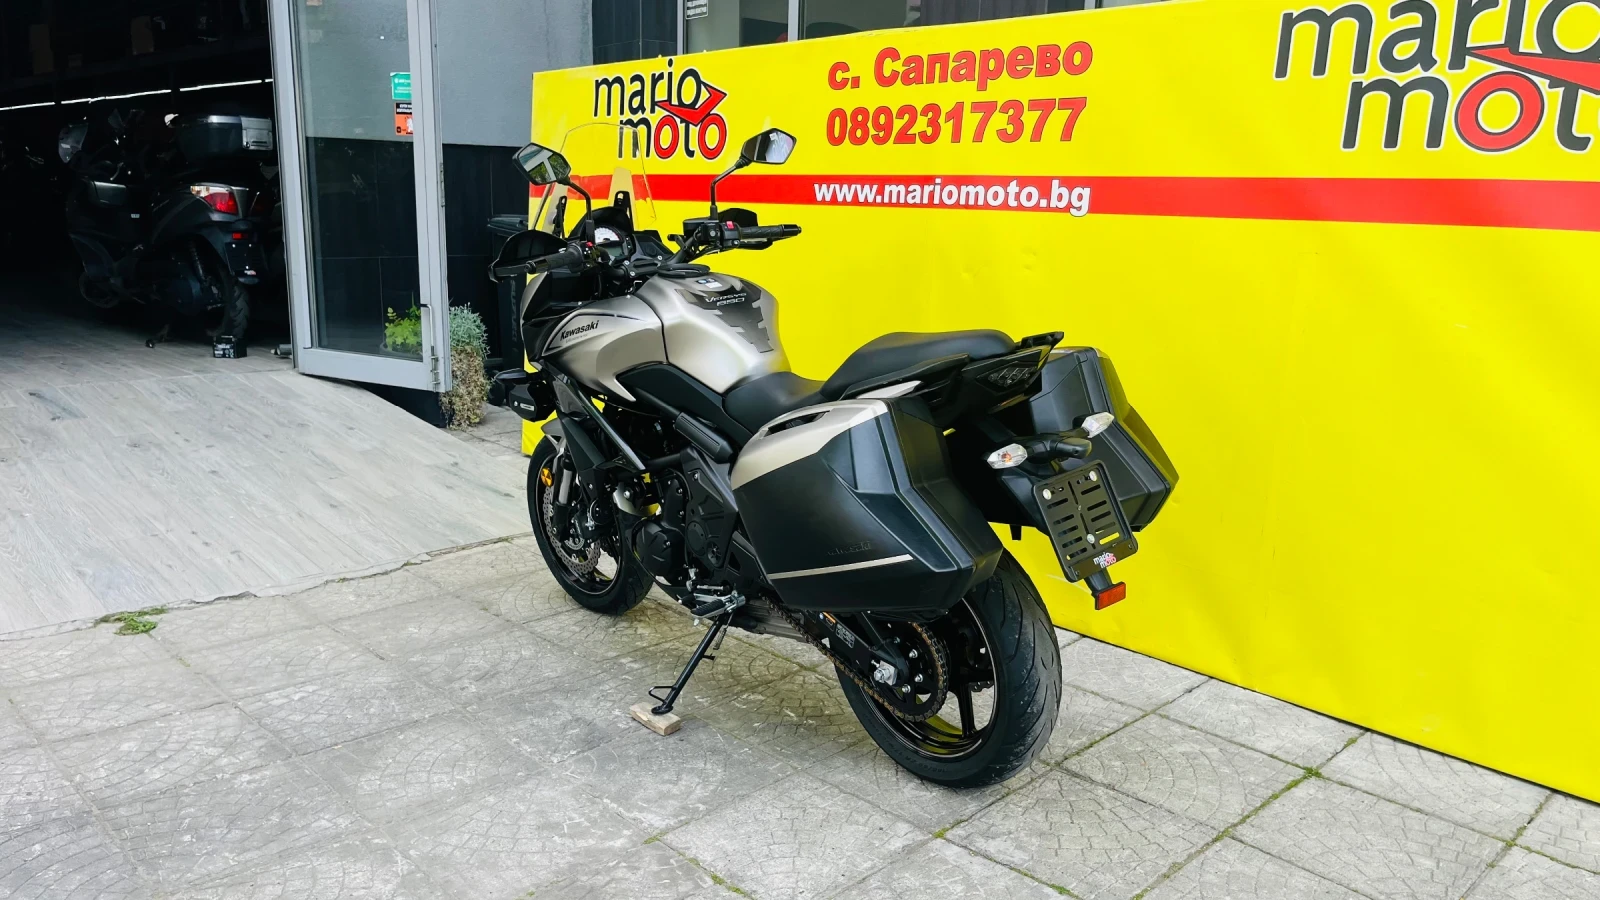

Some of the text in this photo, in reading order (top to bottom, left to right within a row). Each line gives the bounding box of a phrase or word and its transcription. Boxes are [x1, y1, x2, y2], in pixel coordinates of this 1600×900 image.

[1274, 0, 1600, 79] mario
[593, 57, 702, 118] mario
[873, 40, 1094, 92] Сапарево
[617, 112, 727, 160] moto
[826, 96, 1088, 147] 0892317377
[1341, 70, 1600, 153] mot
[813, 177, 1091, 218] www.mariomoto.bg
[560, 319, 600, 341] Kawasaki
